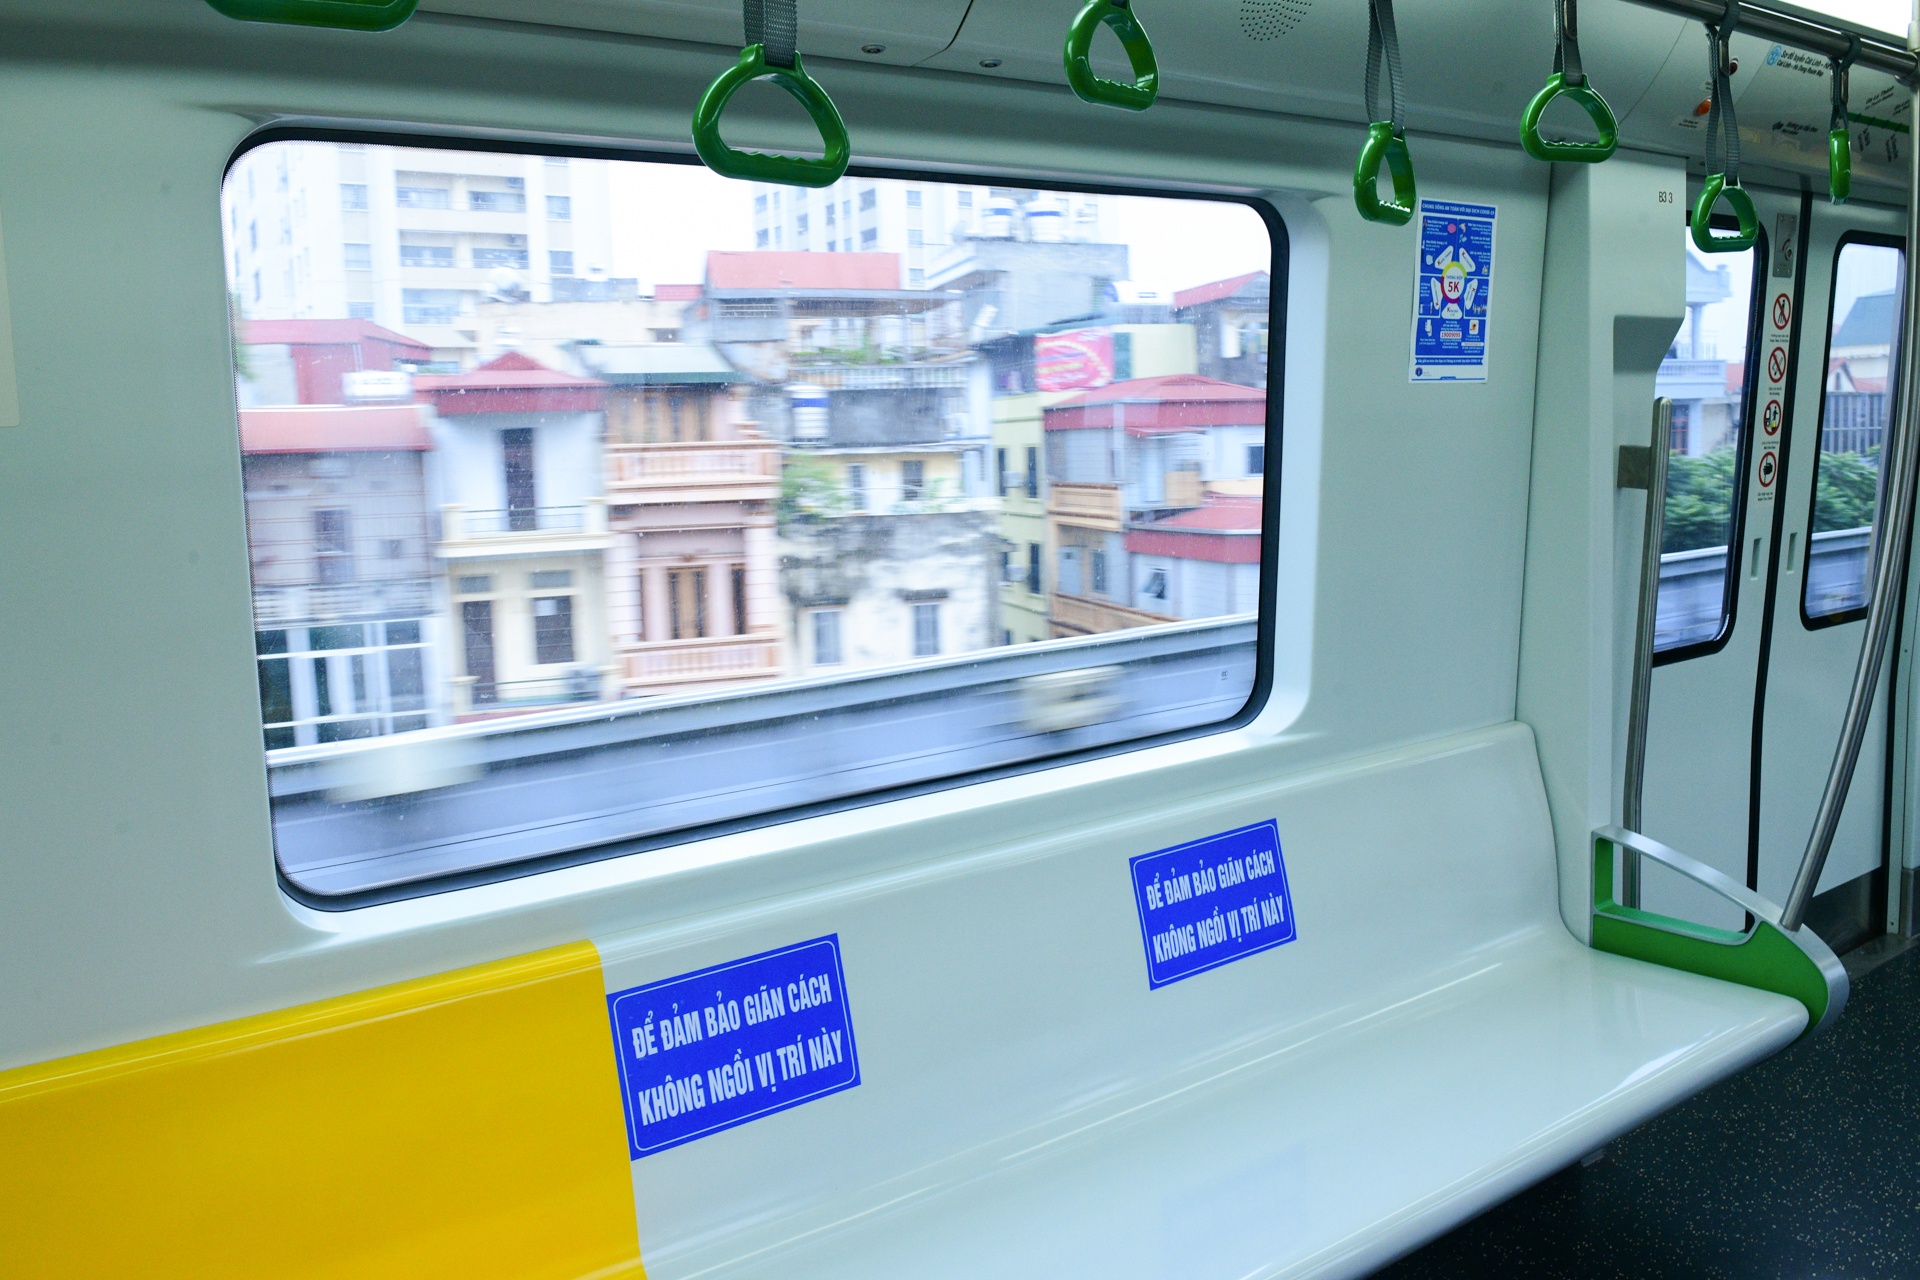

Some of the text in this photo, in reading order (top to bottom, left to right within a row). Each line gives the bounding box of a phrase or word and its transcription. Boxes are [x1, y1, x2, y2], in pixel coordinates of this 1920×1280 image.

[1812, 57, 1821, 66] Linh
[1448, 281, 1459, 292] 5K
[1146, 849, 1276, 911] ĐỂ ĐẢM BẢO GIÃN CÁCH
[1152, 892, 1285, 964] KHÔNG NGỒI VỊ TRÍ NÀY
[631, 973, 832, 1059] ĐỂ ĐẢM BẢO GIÃN CÁCH
[638, 1027, 843, 1126] KHÔNG NGỒI VỊ TRÍ NÀY
